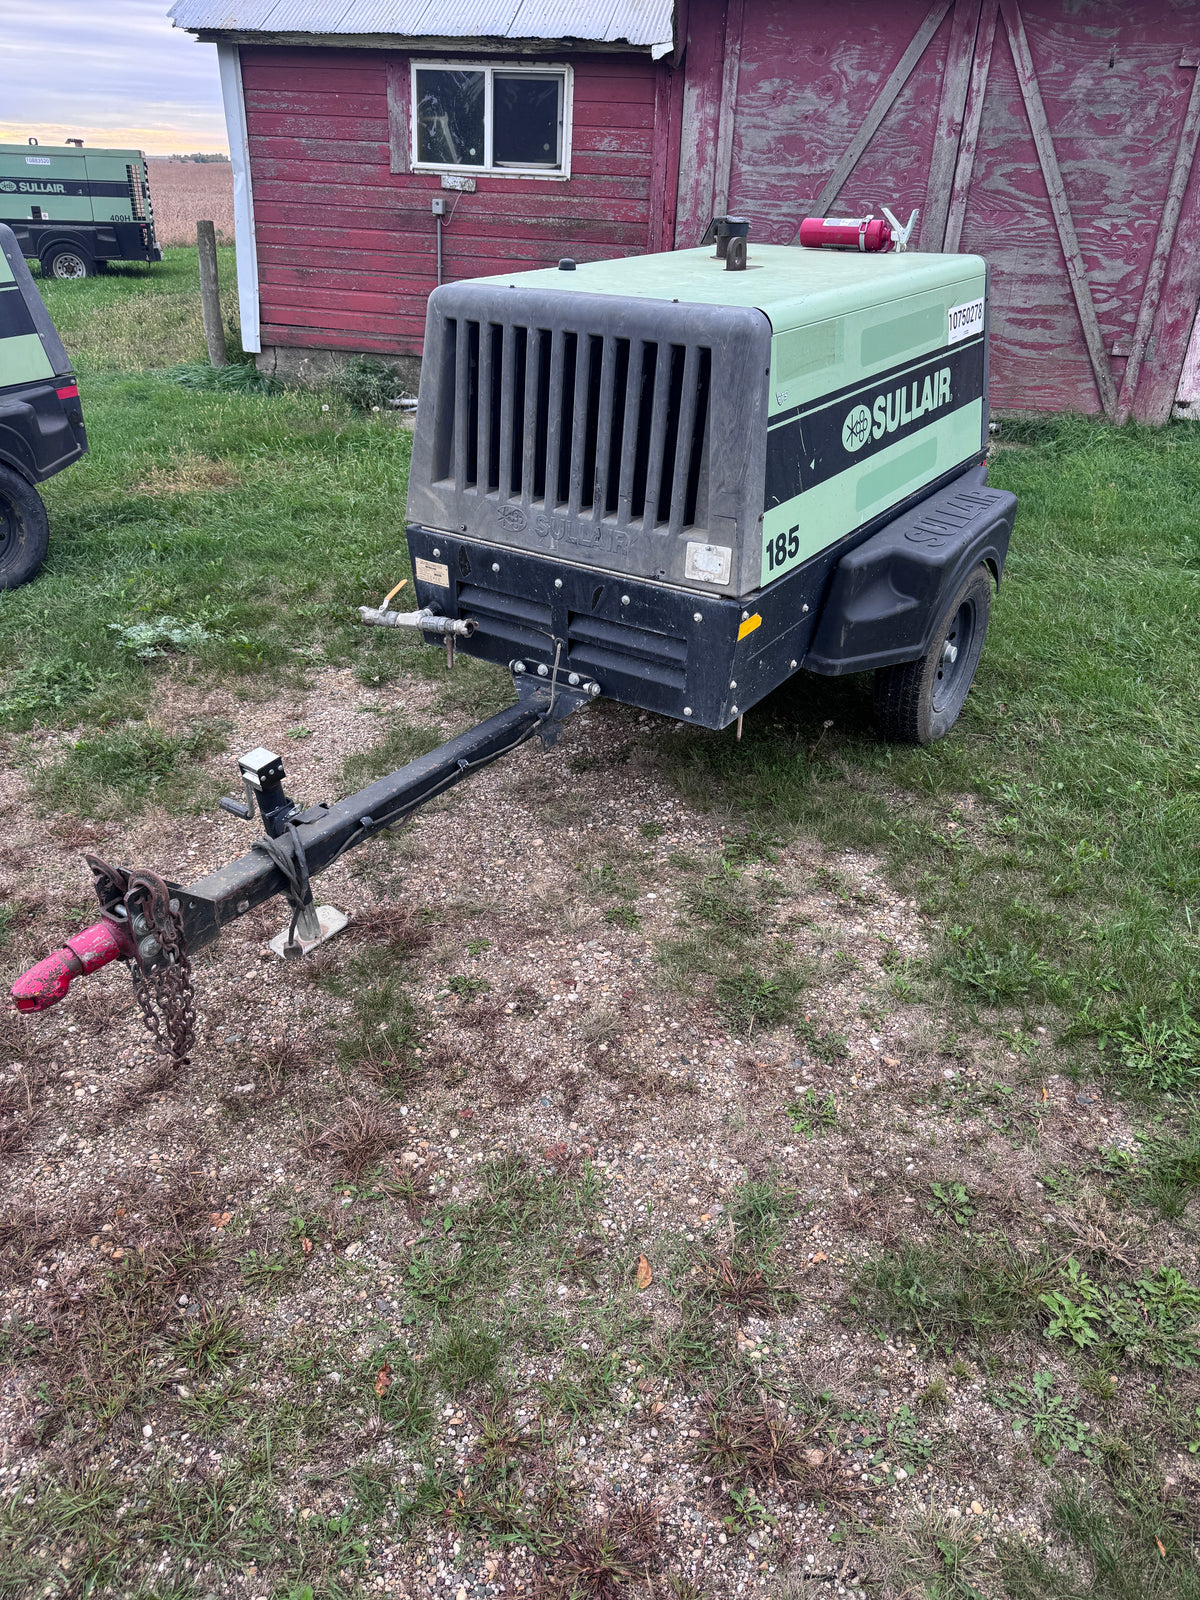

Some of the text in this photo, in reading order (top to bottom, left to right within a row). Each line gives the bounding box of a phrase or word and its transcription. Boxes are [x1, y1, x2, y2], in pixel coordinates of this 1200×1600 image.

[19, 182, 65, 193] SULLAIR
[948, 303, 983, 331] 10750278
[872, 366, 952, 440] SULLAIR
[534, 514, 630, 556] SULLAIR
[904, 491, 1002, 547] SULLAIR
[766, 525, 800, 570] 185
